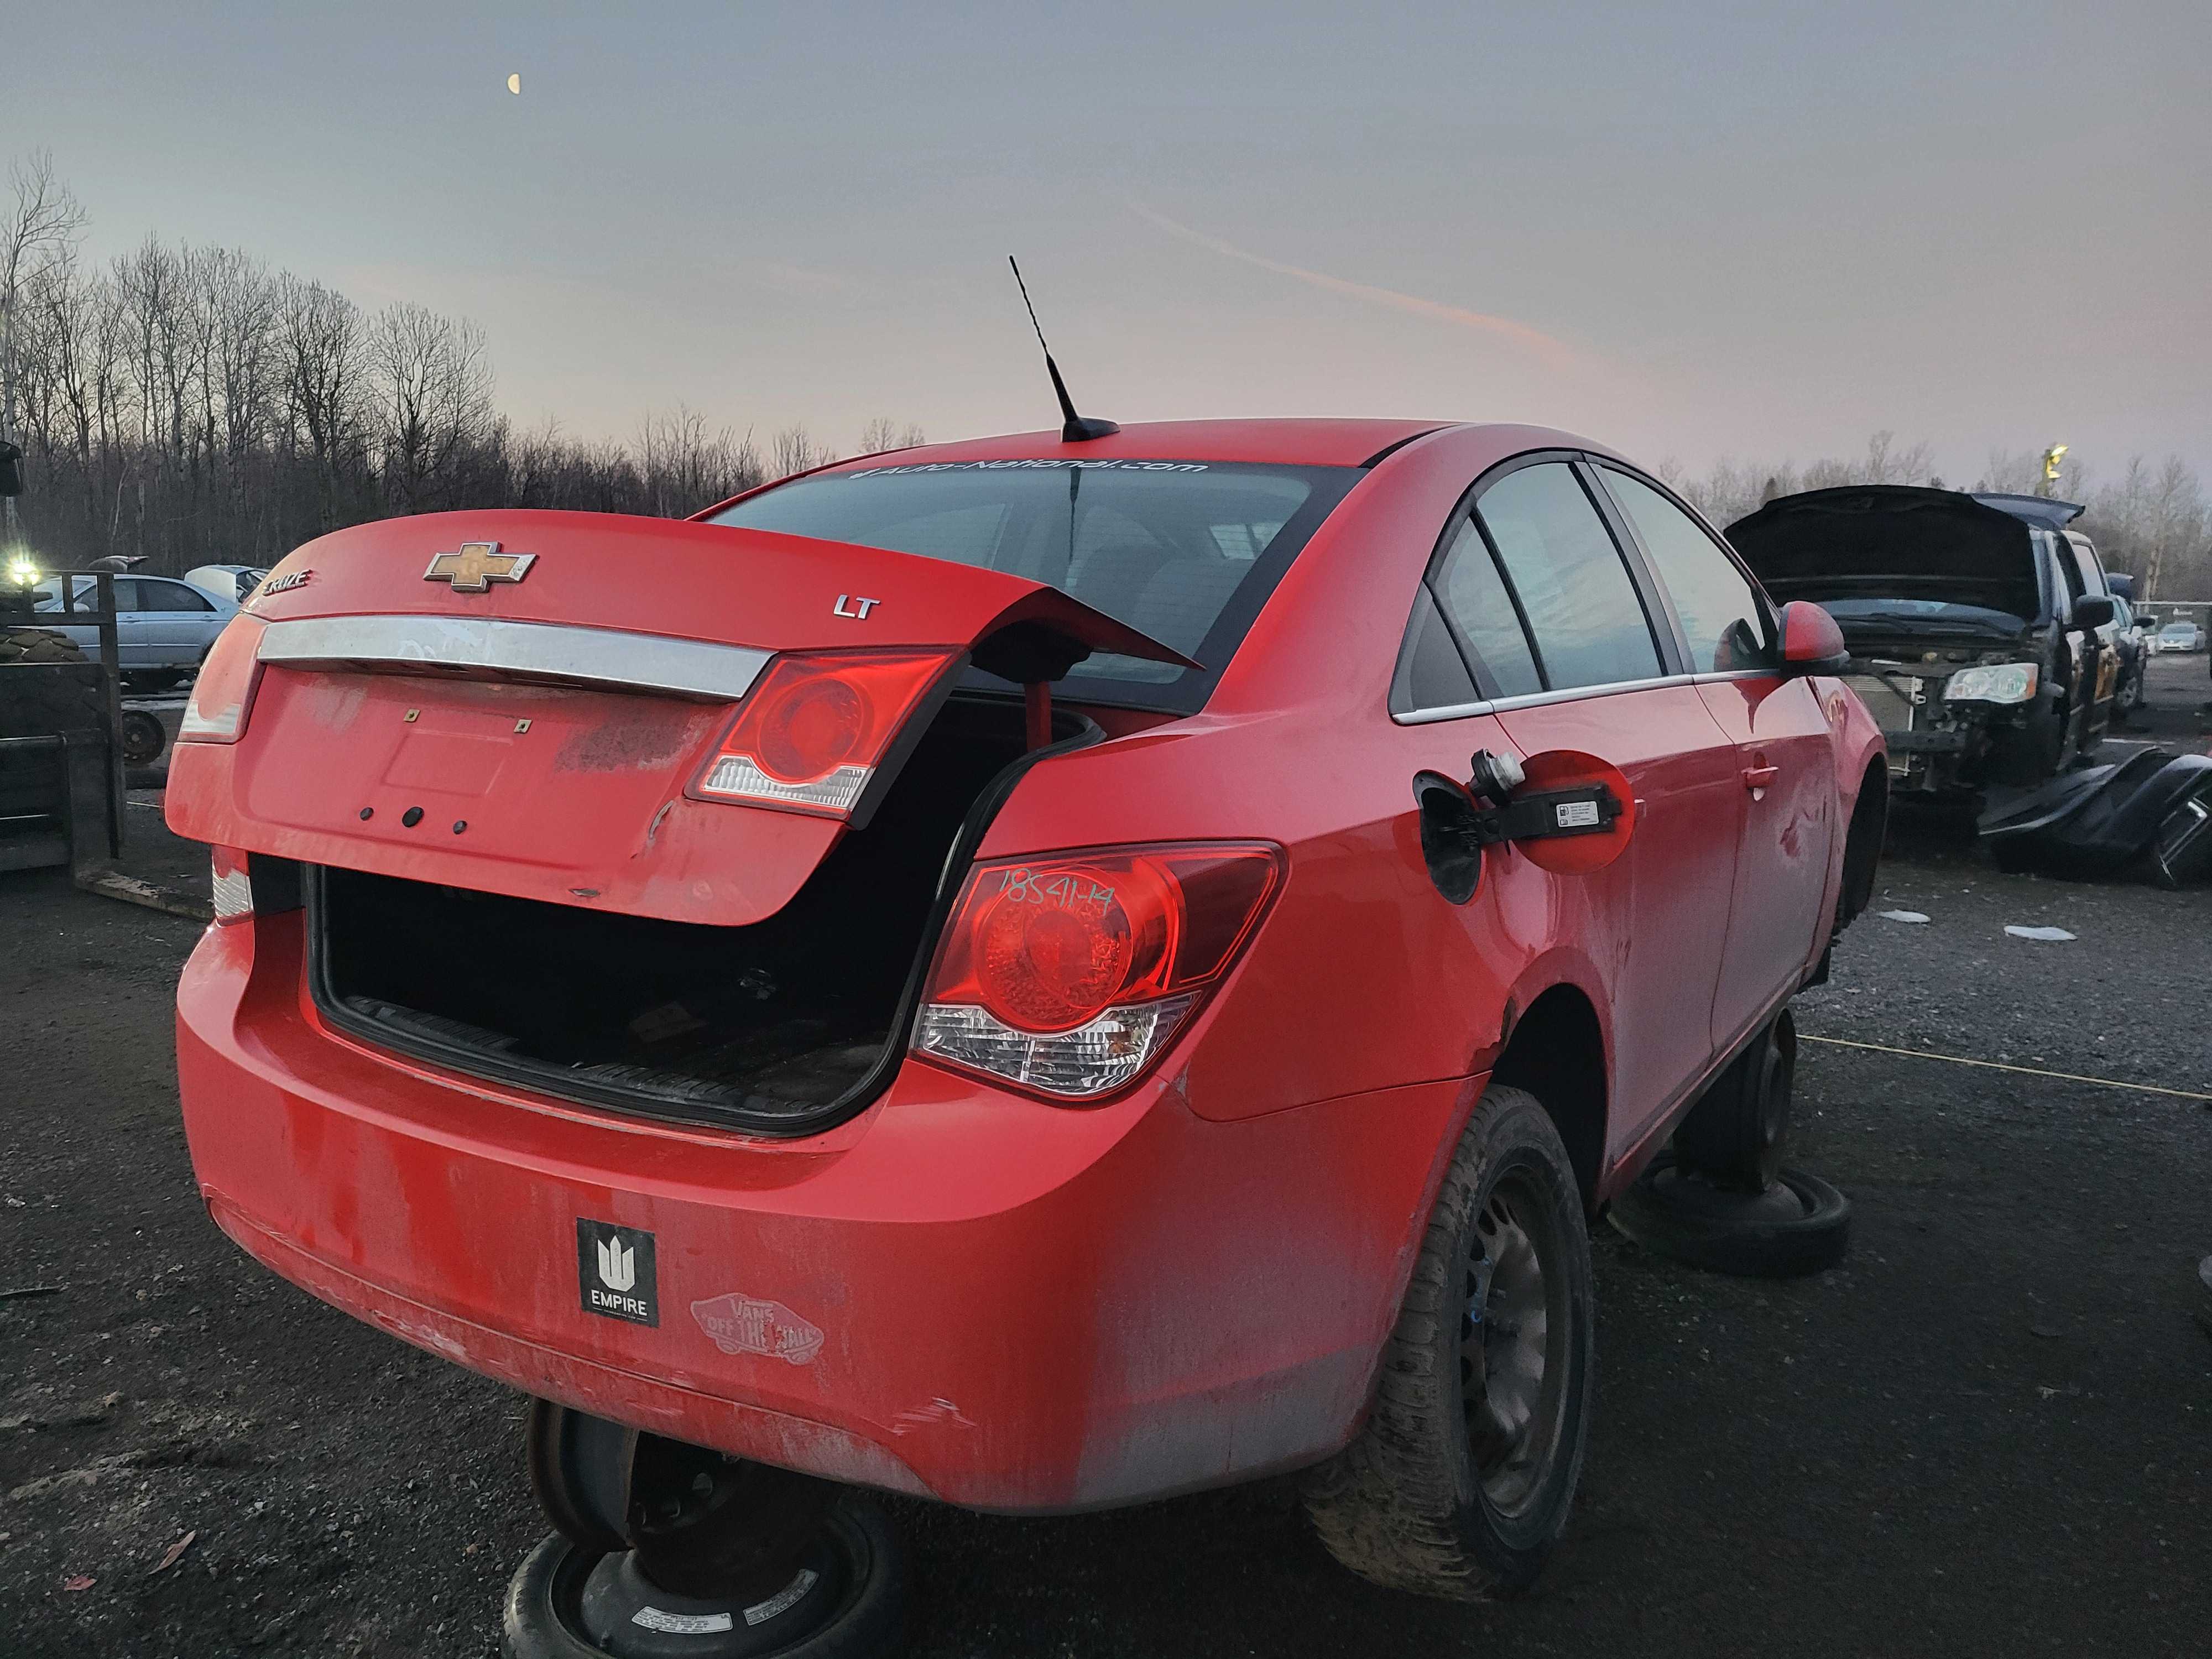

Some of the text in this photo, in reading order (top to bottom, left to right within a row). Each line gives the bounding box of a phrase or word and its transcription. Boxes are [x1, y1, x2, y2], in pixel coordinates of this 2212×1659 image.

[262, 568, 312, 595] CRUZE
[833, 594, 881, 619] LT
[591, 1289, 648, 1316] EMPIRE
[729, 1298, 775, 1324] VANS
